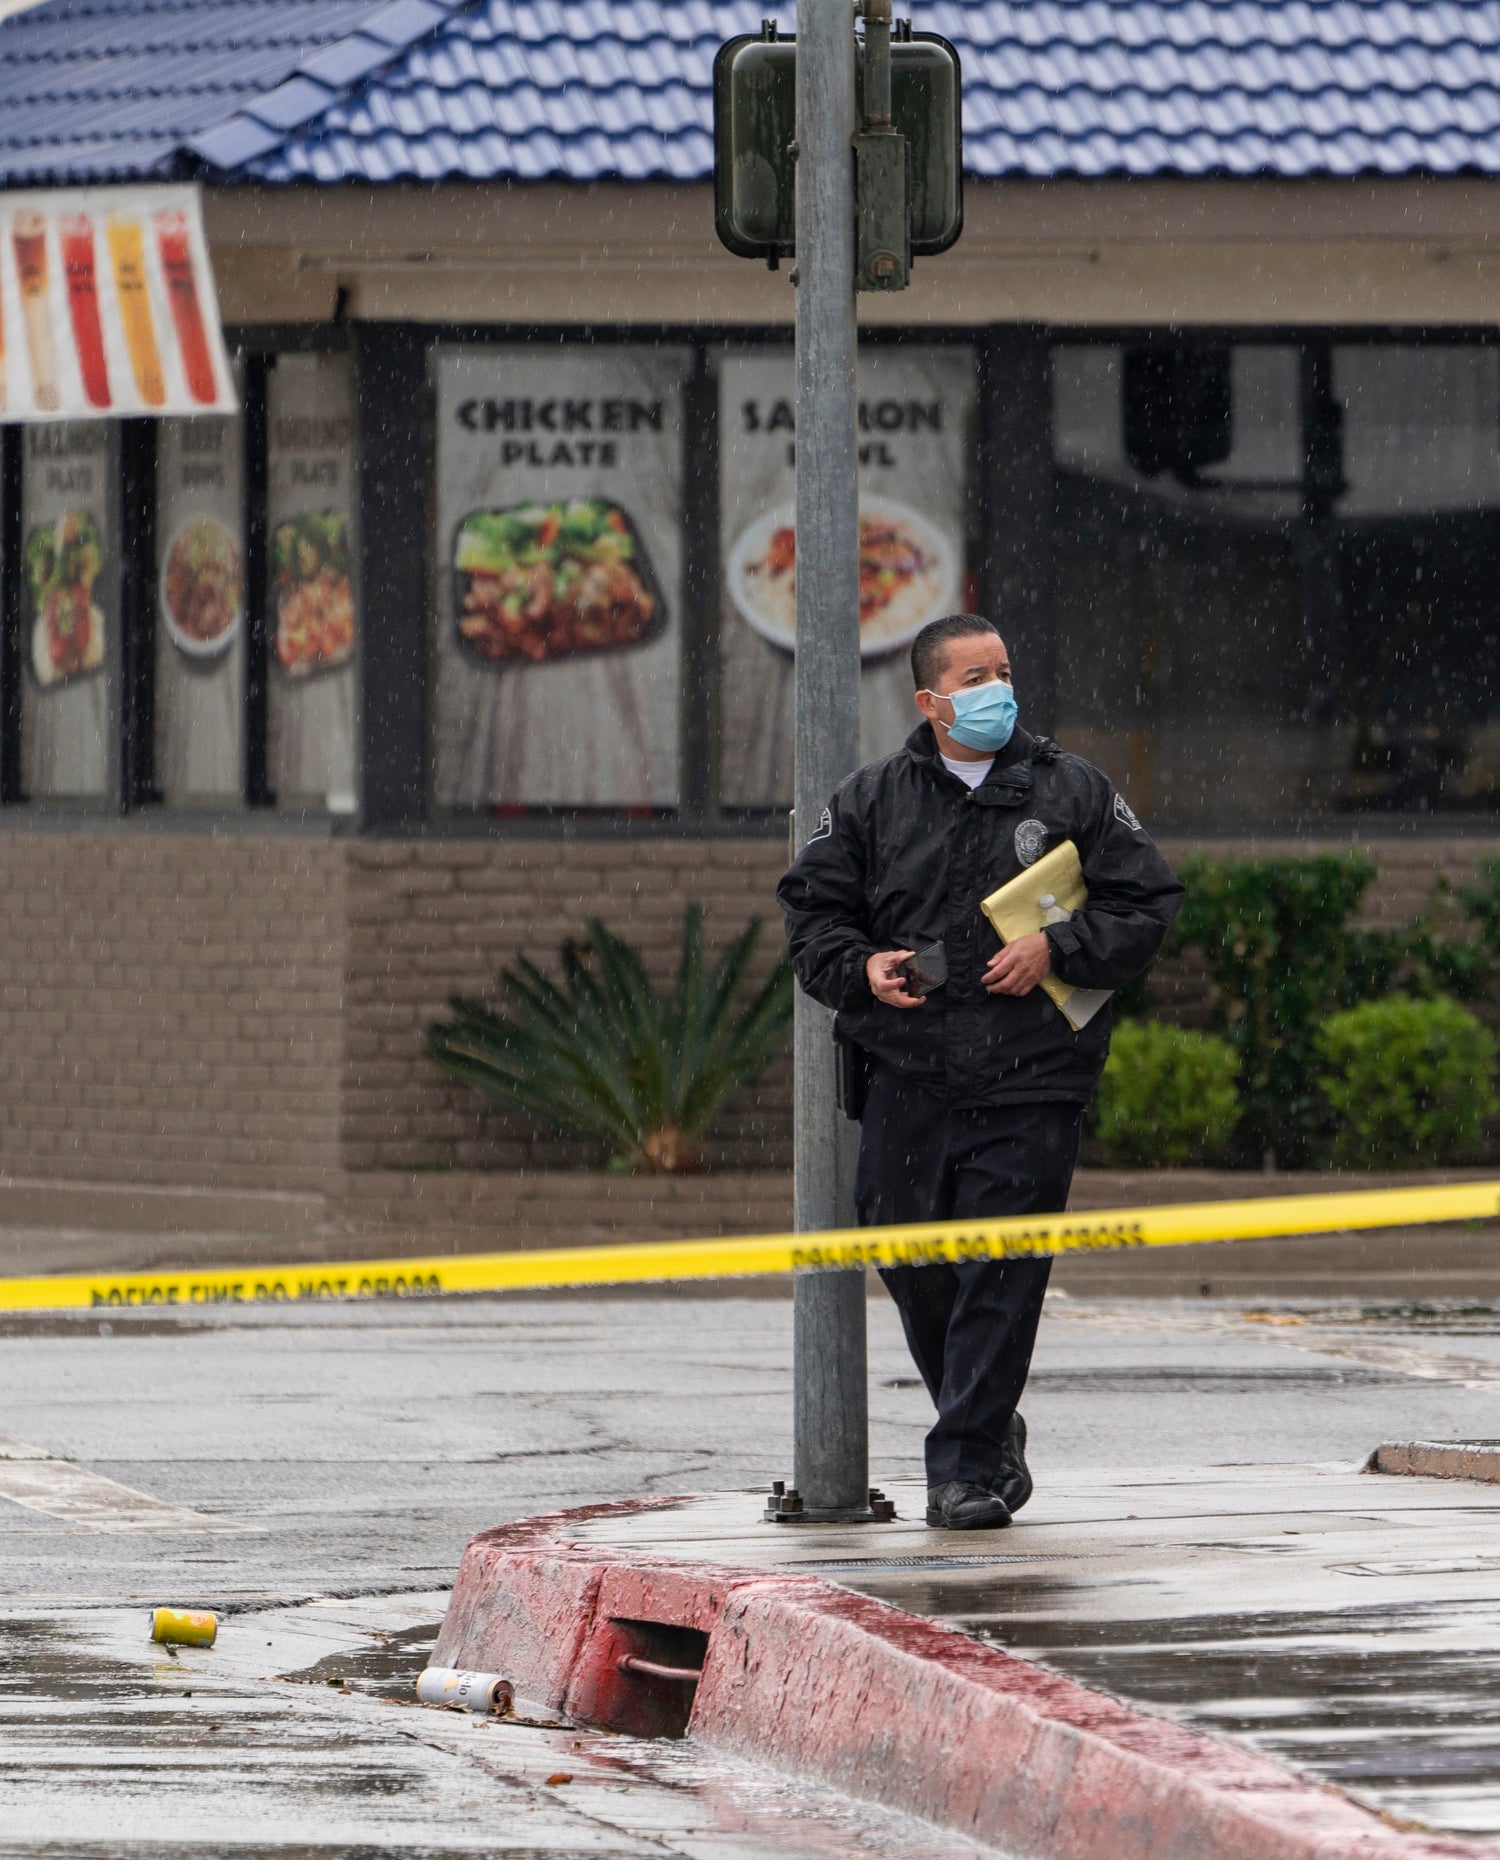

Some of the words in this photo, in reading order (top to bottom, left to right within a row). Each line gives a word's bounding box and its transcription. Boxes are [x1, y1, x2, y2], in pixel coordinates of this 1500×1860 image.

[456, 398, 663, 432] CHICKEN
[742, 397, 943, 432] SAON
[503, 439, 616, 469] PLATE
[792, 1243, 879, 1269] POLICE
[890, 1238, 944, 1265] LINE
[956, 1235, 988, 1261] DO
[1000, 1229, 1051, 1258] NOT
[1062, 1222, 1142, 1249] CROSS
